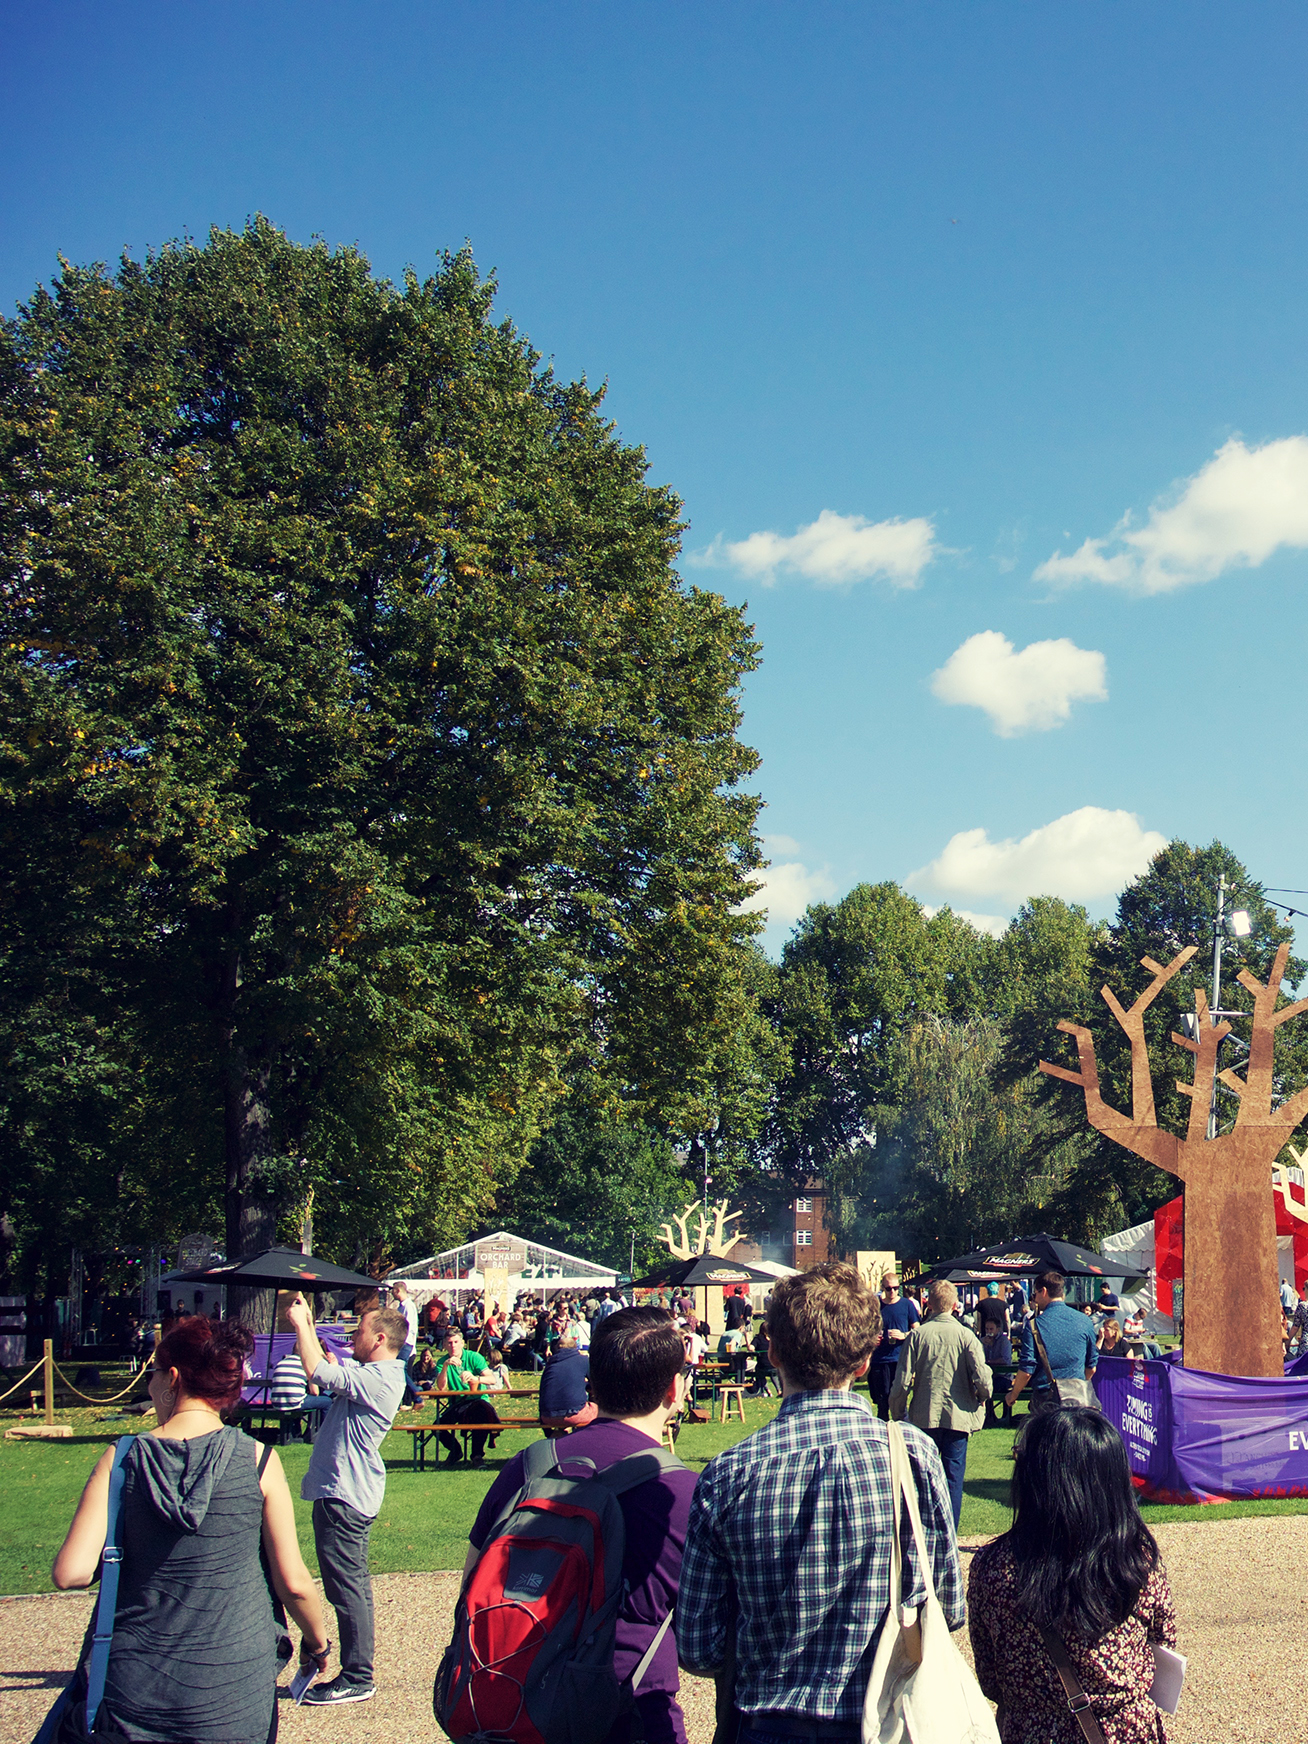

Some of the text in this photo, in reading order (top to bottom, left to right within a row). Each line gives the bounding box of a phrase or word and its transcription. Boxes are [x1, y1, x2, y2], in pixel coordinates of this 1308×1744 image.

[480, 1253, 521, 1261] ORCHARD
[492, 1261, 509, 1269] BAR
[1122, 1412, 1157, 1445] EVERYTHING
